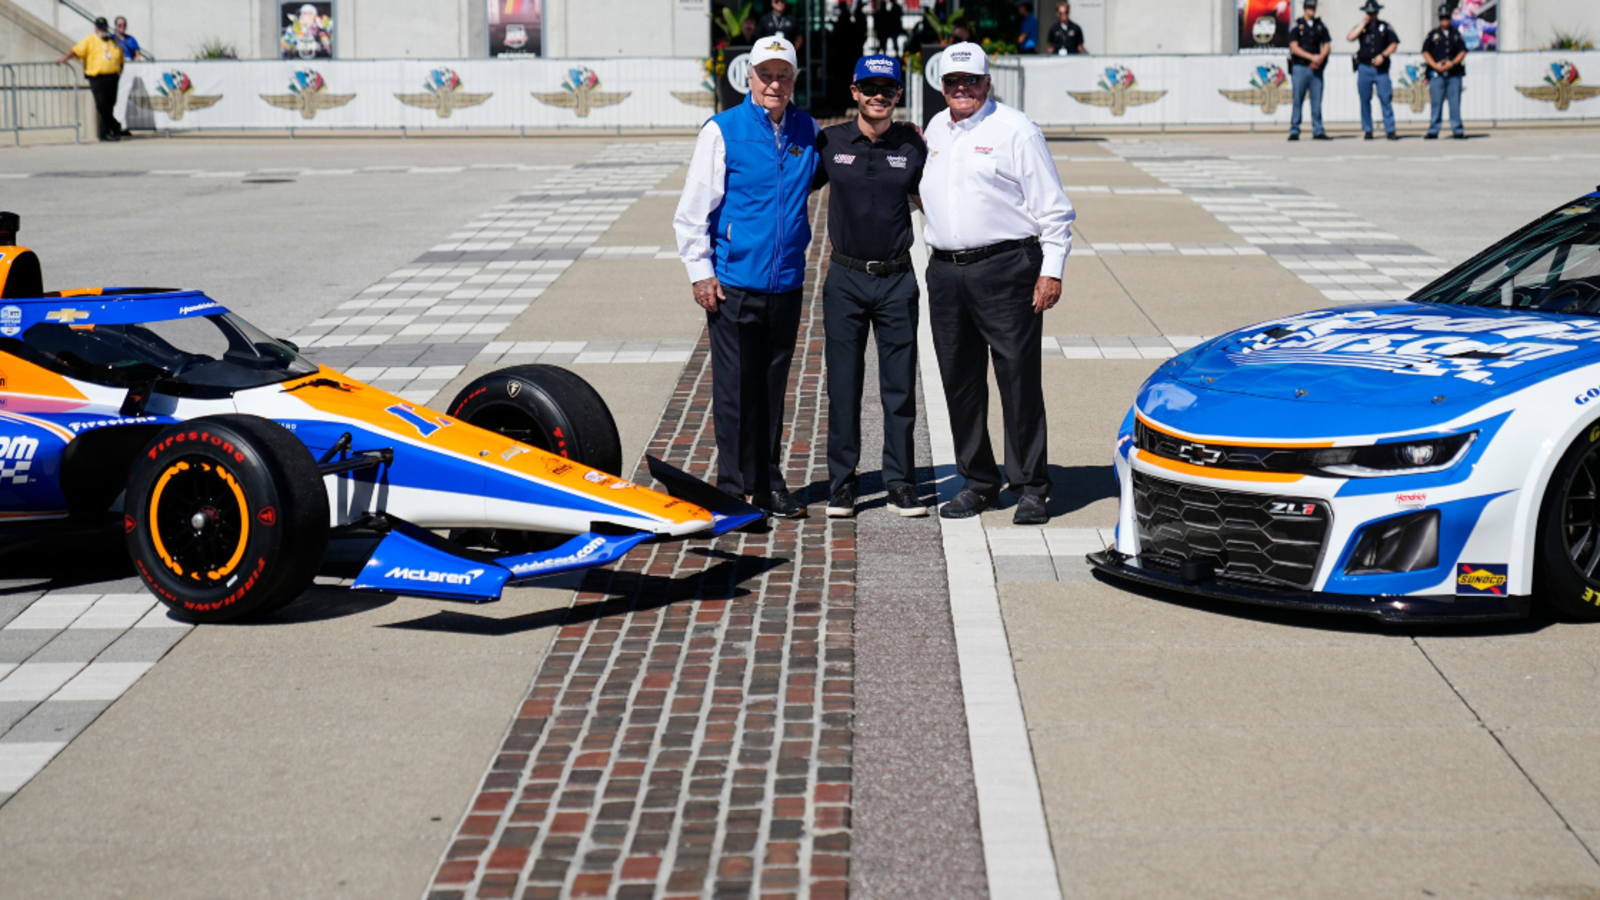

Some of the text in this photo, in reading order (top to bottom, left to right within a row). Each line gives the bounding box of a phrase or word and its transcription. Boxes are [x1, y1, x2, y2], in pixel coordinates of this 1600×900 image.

[68, 416, 157, 432] Firestone
[148, 431, 245, 463] Firestone
[1395, 493, 1426, 503] Hendrick
[1269, 502, 1315, 515] ZL1
[183, 556, 266, 611] FIREHAWK
[384, 567, 472, 585] McLaren
[1460, 575, 1505, 584] SUNOCO
